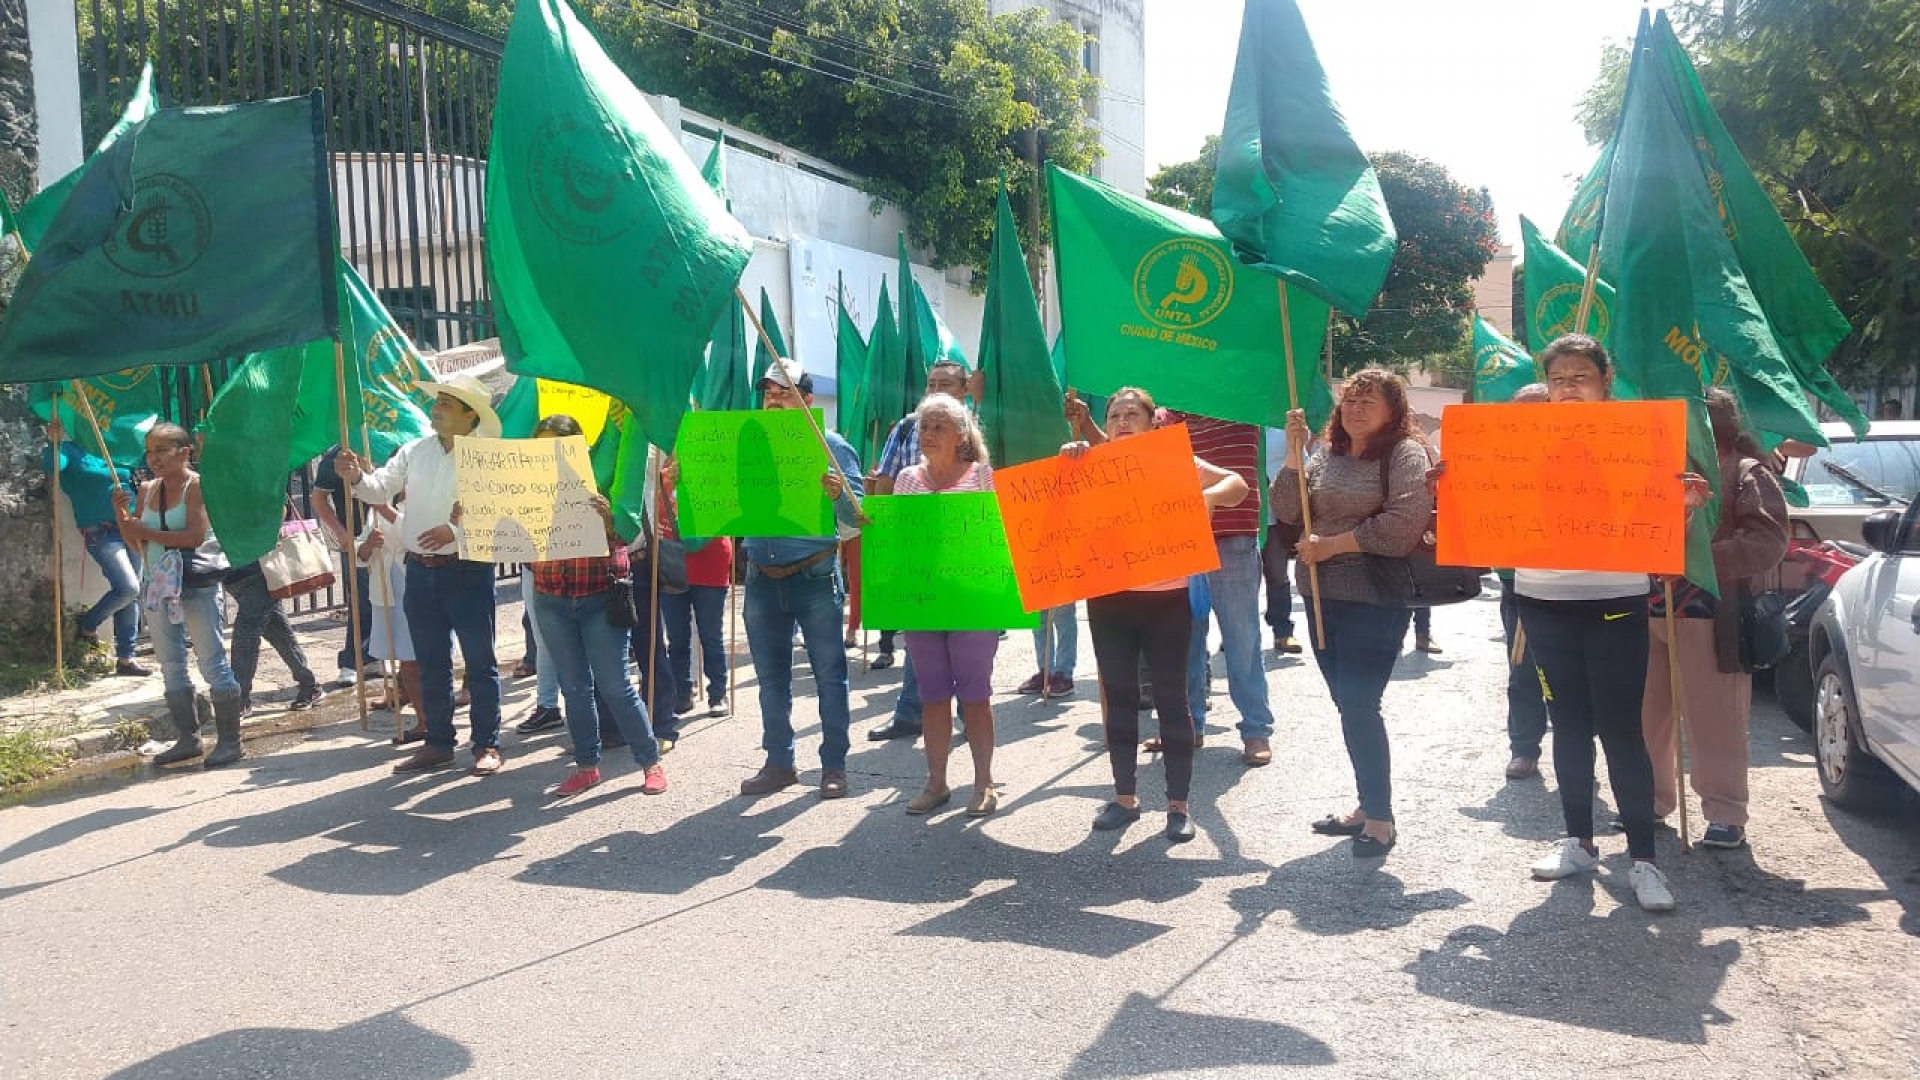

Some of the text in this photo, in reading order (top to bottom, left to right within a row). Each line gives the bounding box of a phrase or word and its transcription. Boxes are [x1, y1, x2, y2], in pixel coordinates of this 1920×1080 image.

[1155, 308, 1191, 324] UNTA
[1120, 323, 1158, 339] CIUDAD
[1159, 329, 1175, 342] DE
[1010, 455, 1147, 504] MARGARITA
